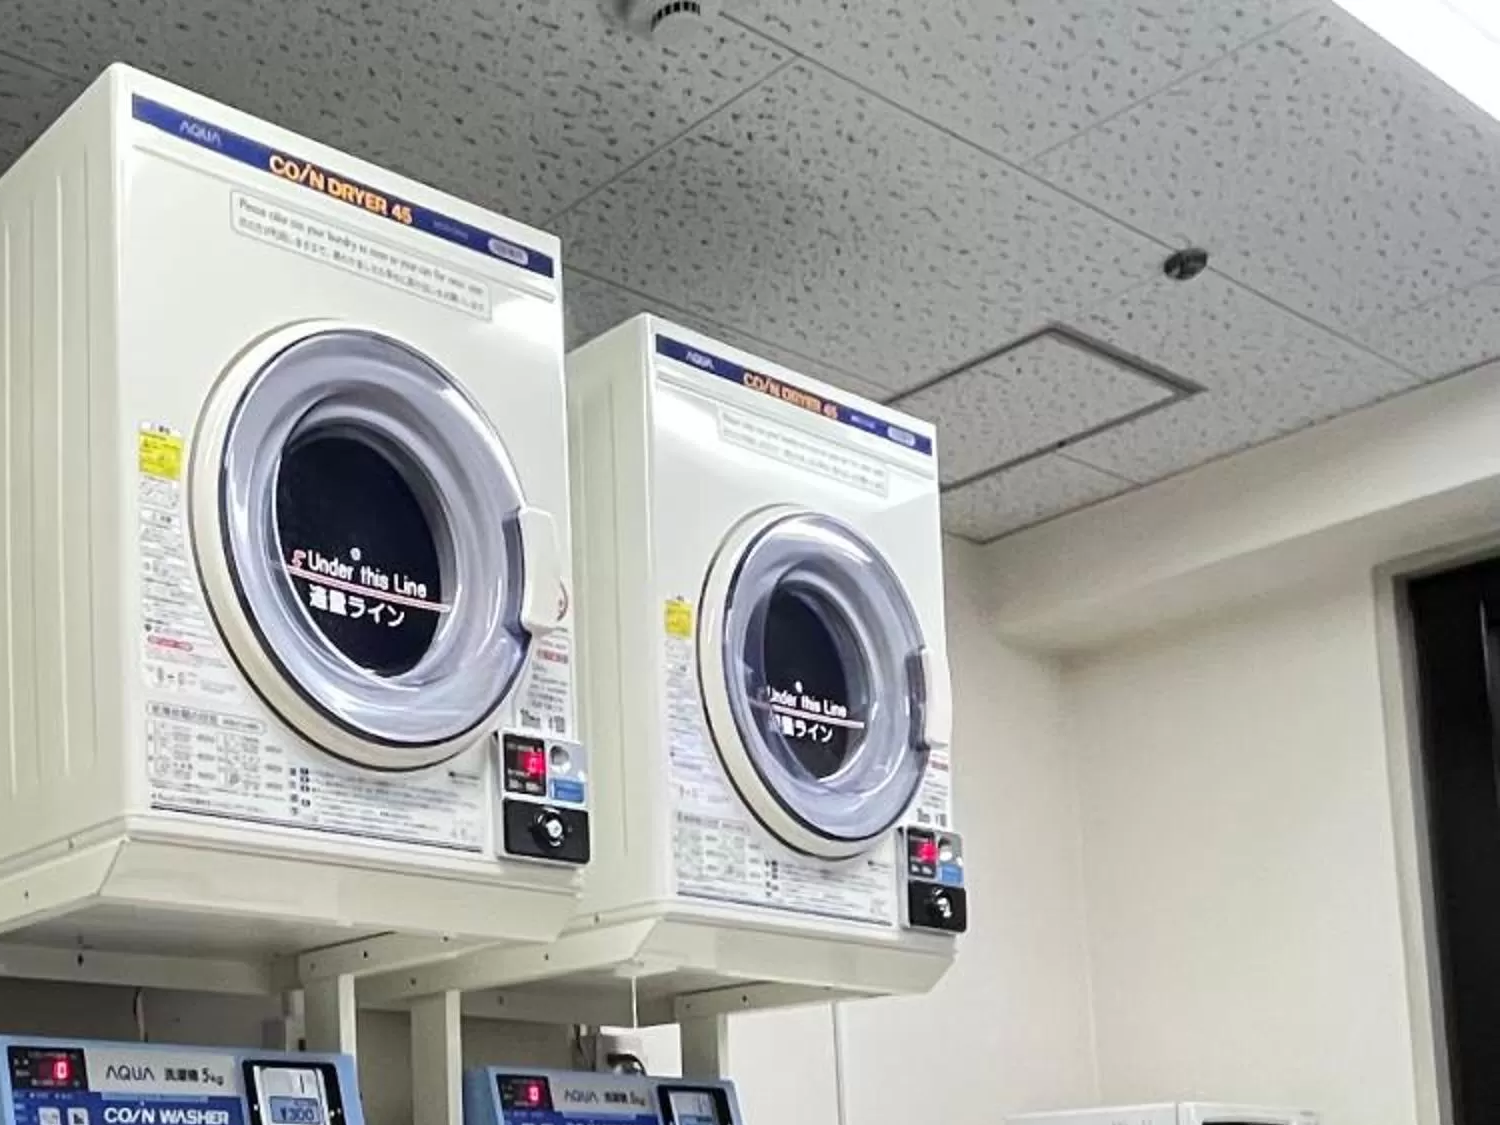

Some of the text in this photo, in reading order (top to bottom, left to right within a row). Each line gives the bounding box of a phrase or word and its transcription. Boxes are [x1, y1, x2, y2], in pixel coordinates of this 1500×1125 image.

[327, 176, 388, 214] DRYER
[307, 549, 428, 599] Under this Line
[105, 1064, 156, 1081] AQUA
